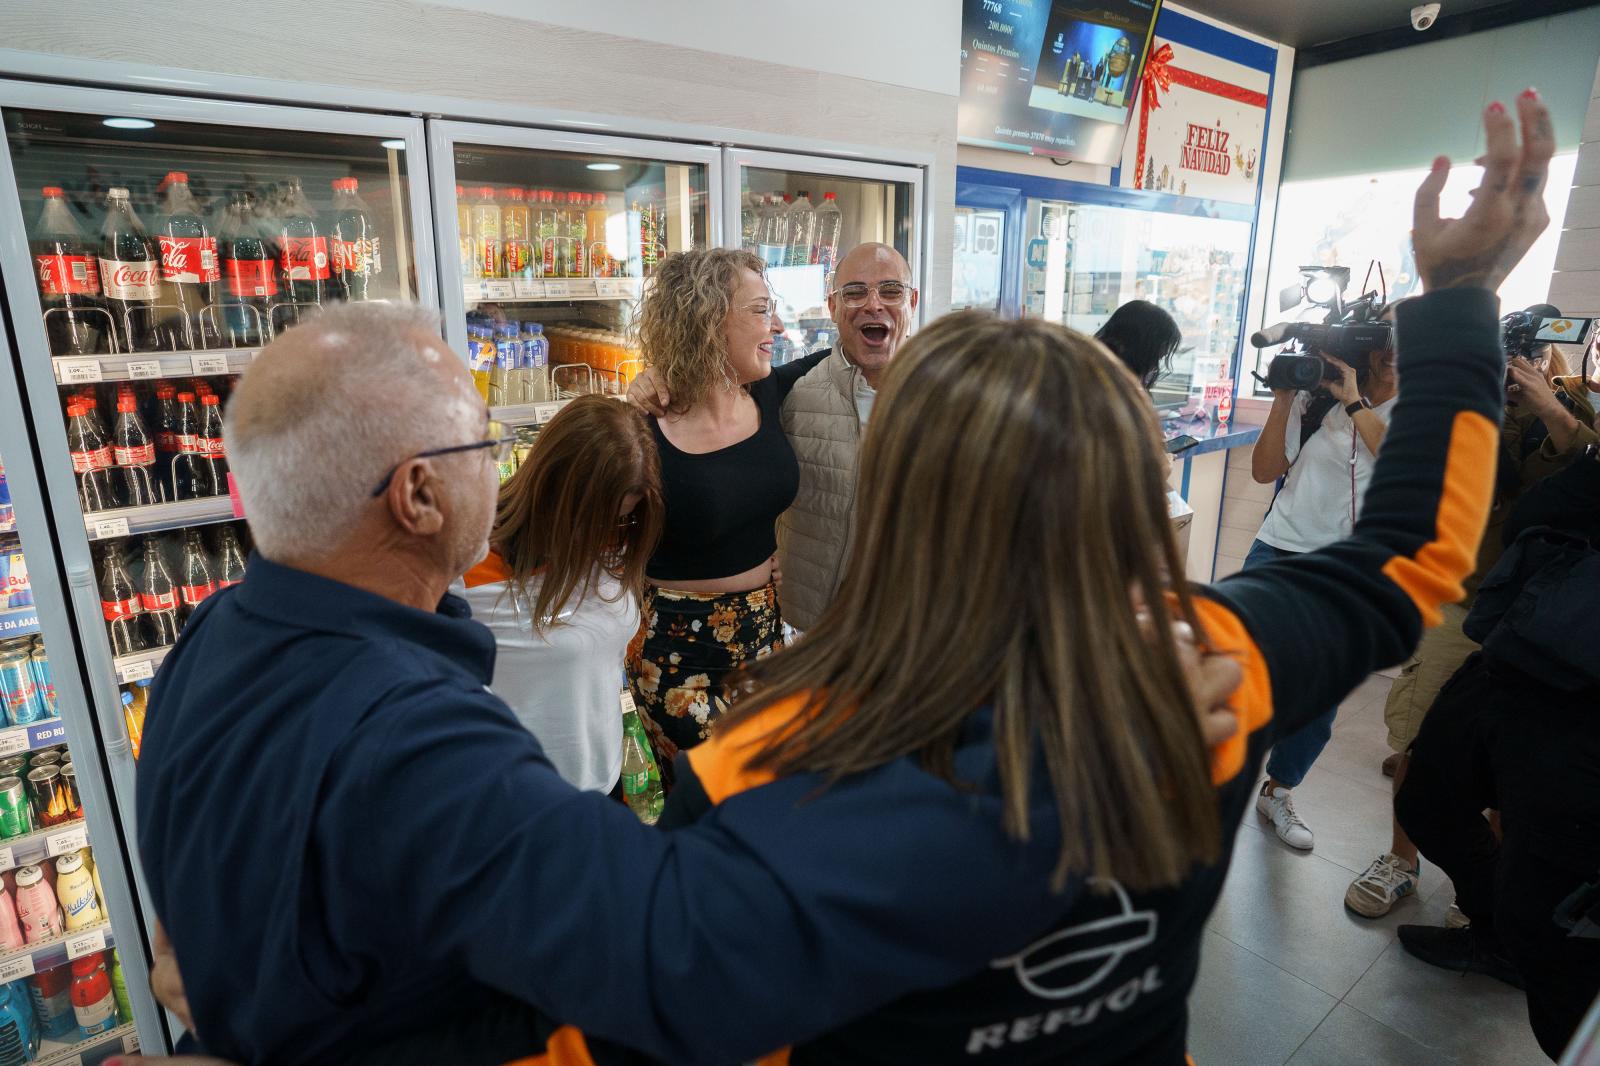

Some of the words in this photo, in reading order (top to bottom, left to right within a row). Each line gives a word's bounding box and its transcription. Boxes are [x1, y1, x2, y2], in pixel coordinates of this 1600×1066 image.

[983, 0, 1003, 14] 77768
[972, 39, 996, 53] Quintos
[1186, 123, 1230, 154] FELIZ
[1180, 145, 1231, 176] NAVIDAD
[4, 621, 17, 630] DA
[36, 730, 52, 740] RED
[53, 727, 65, 737] BU
